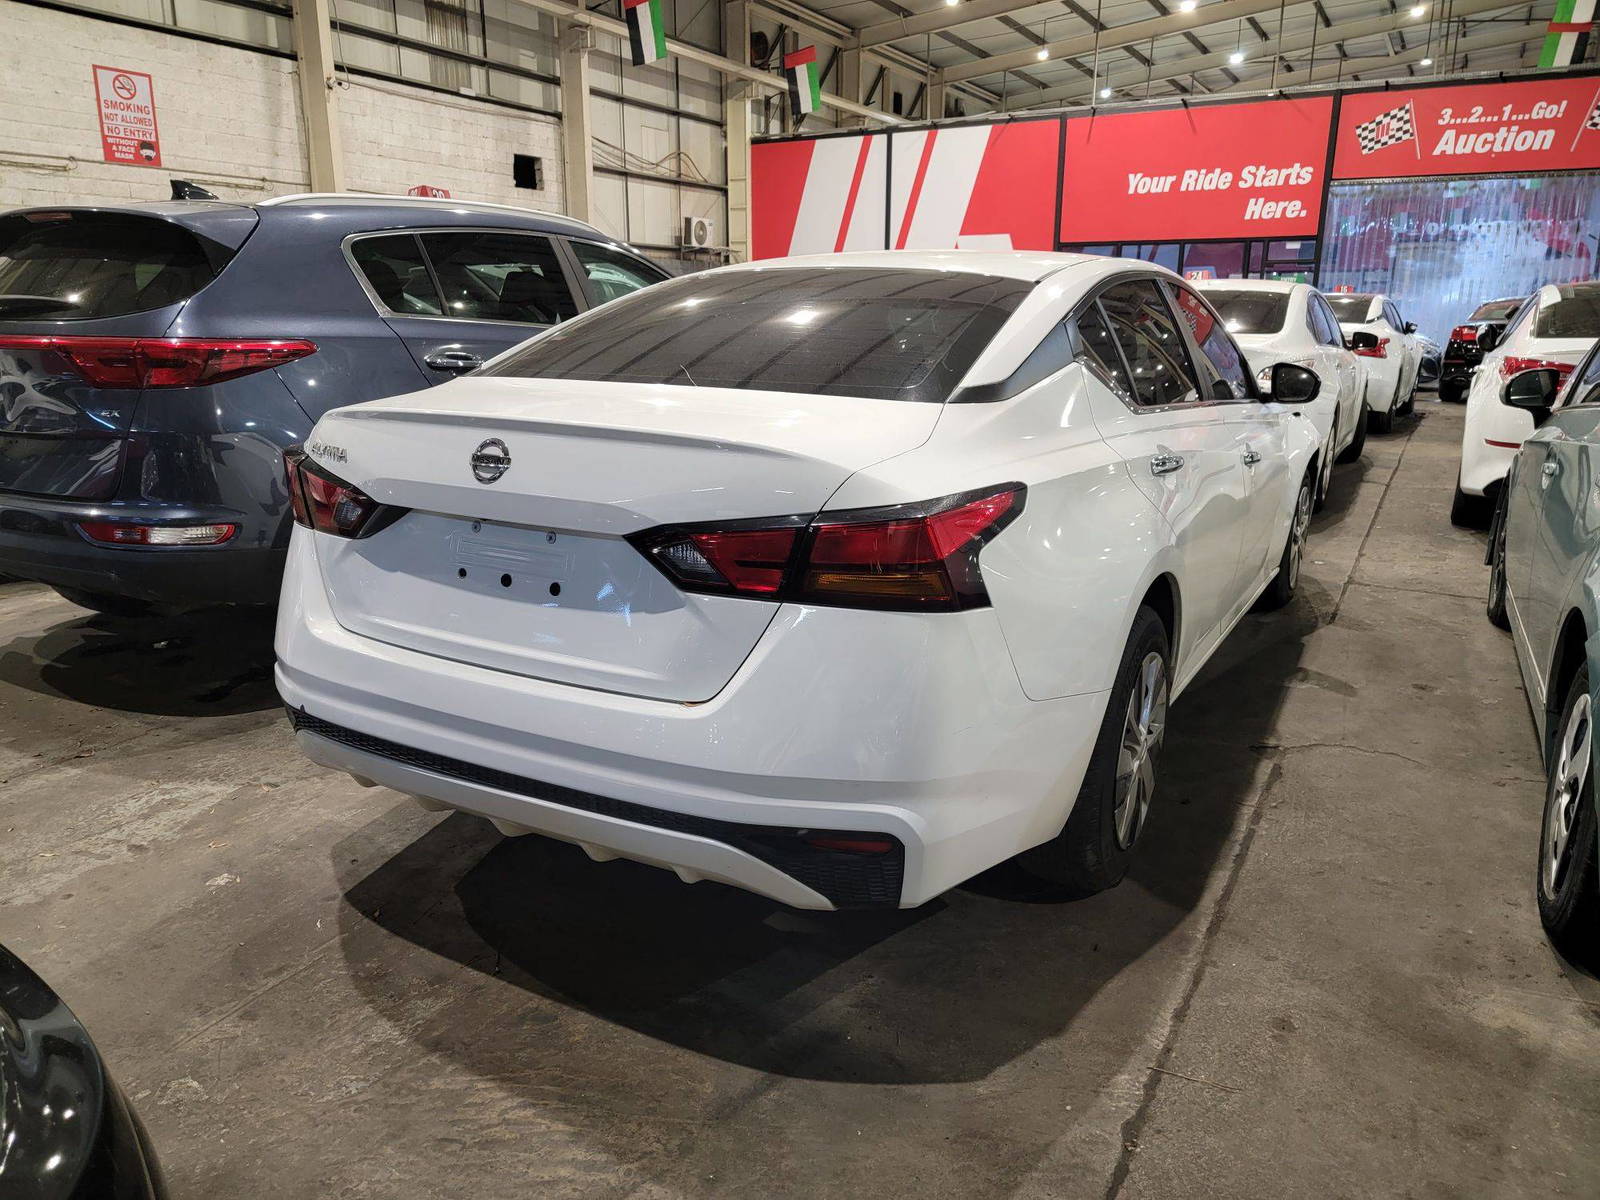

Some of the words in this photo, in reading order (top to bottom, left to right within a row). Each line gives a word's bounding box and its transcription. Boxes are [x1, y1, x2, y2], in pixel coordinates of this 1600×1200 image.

[103, 99, 150, 115] SMOKING
[104, 112, 119, 122] NOT
[121, 115, 153, 127] ALLOWED
[107, 126, 121, 136] NO
[123, 128, 153, 139] ENTRY
[107, 138, 138, 146] WITHOUT
[1432, 125, 1556, 156] Auction
[1128, 173, 1176, 194] Your
[1180, 168, 1233, 192] Ride
[1238, 163, 1314, 189] Starts
[1244, 198, 1307, 220] Here.
[472, 454, 507, 466] NISSAN
